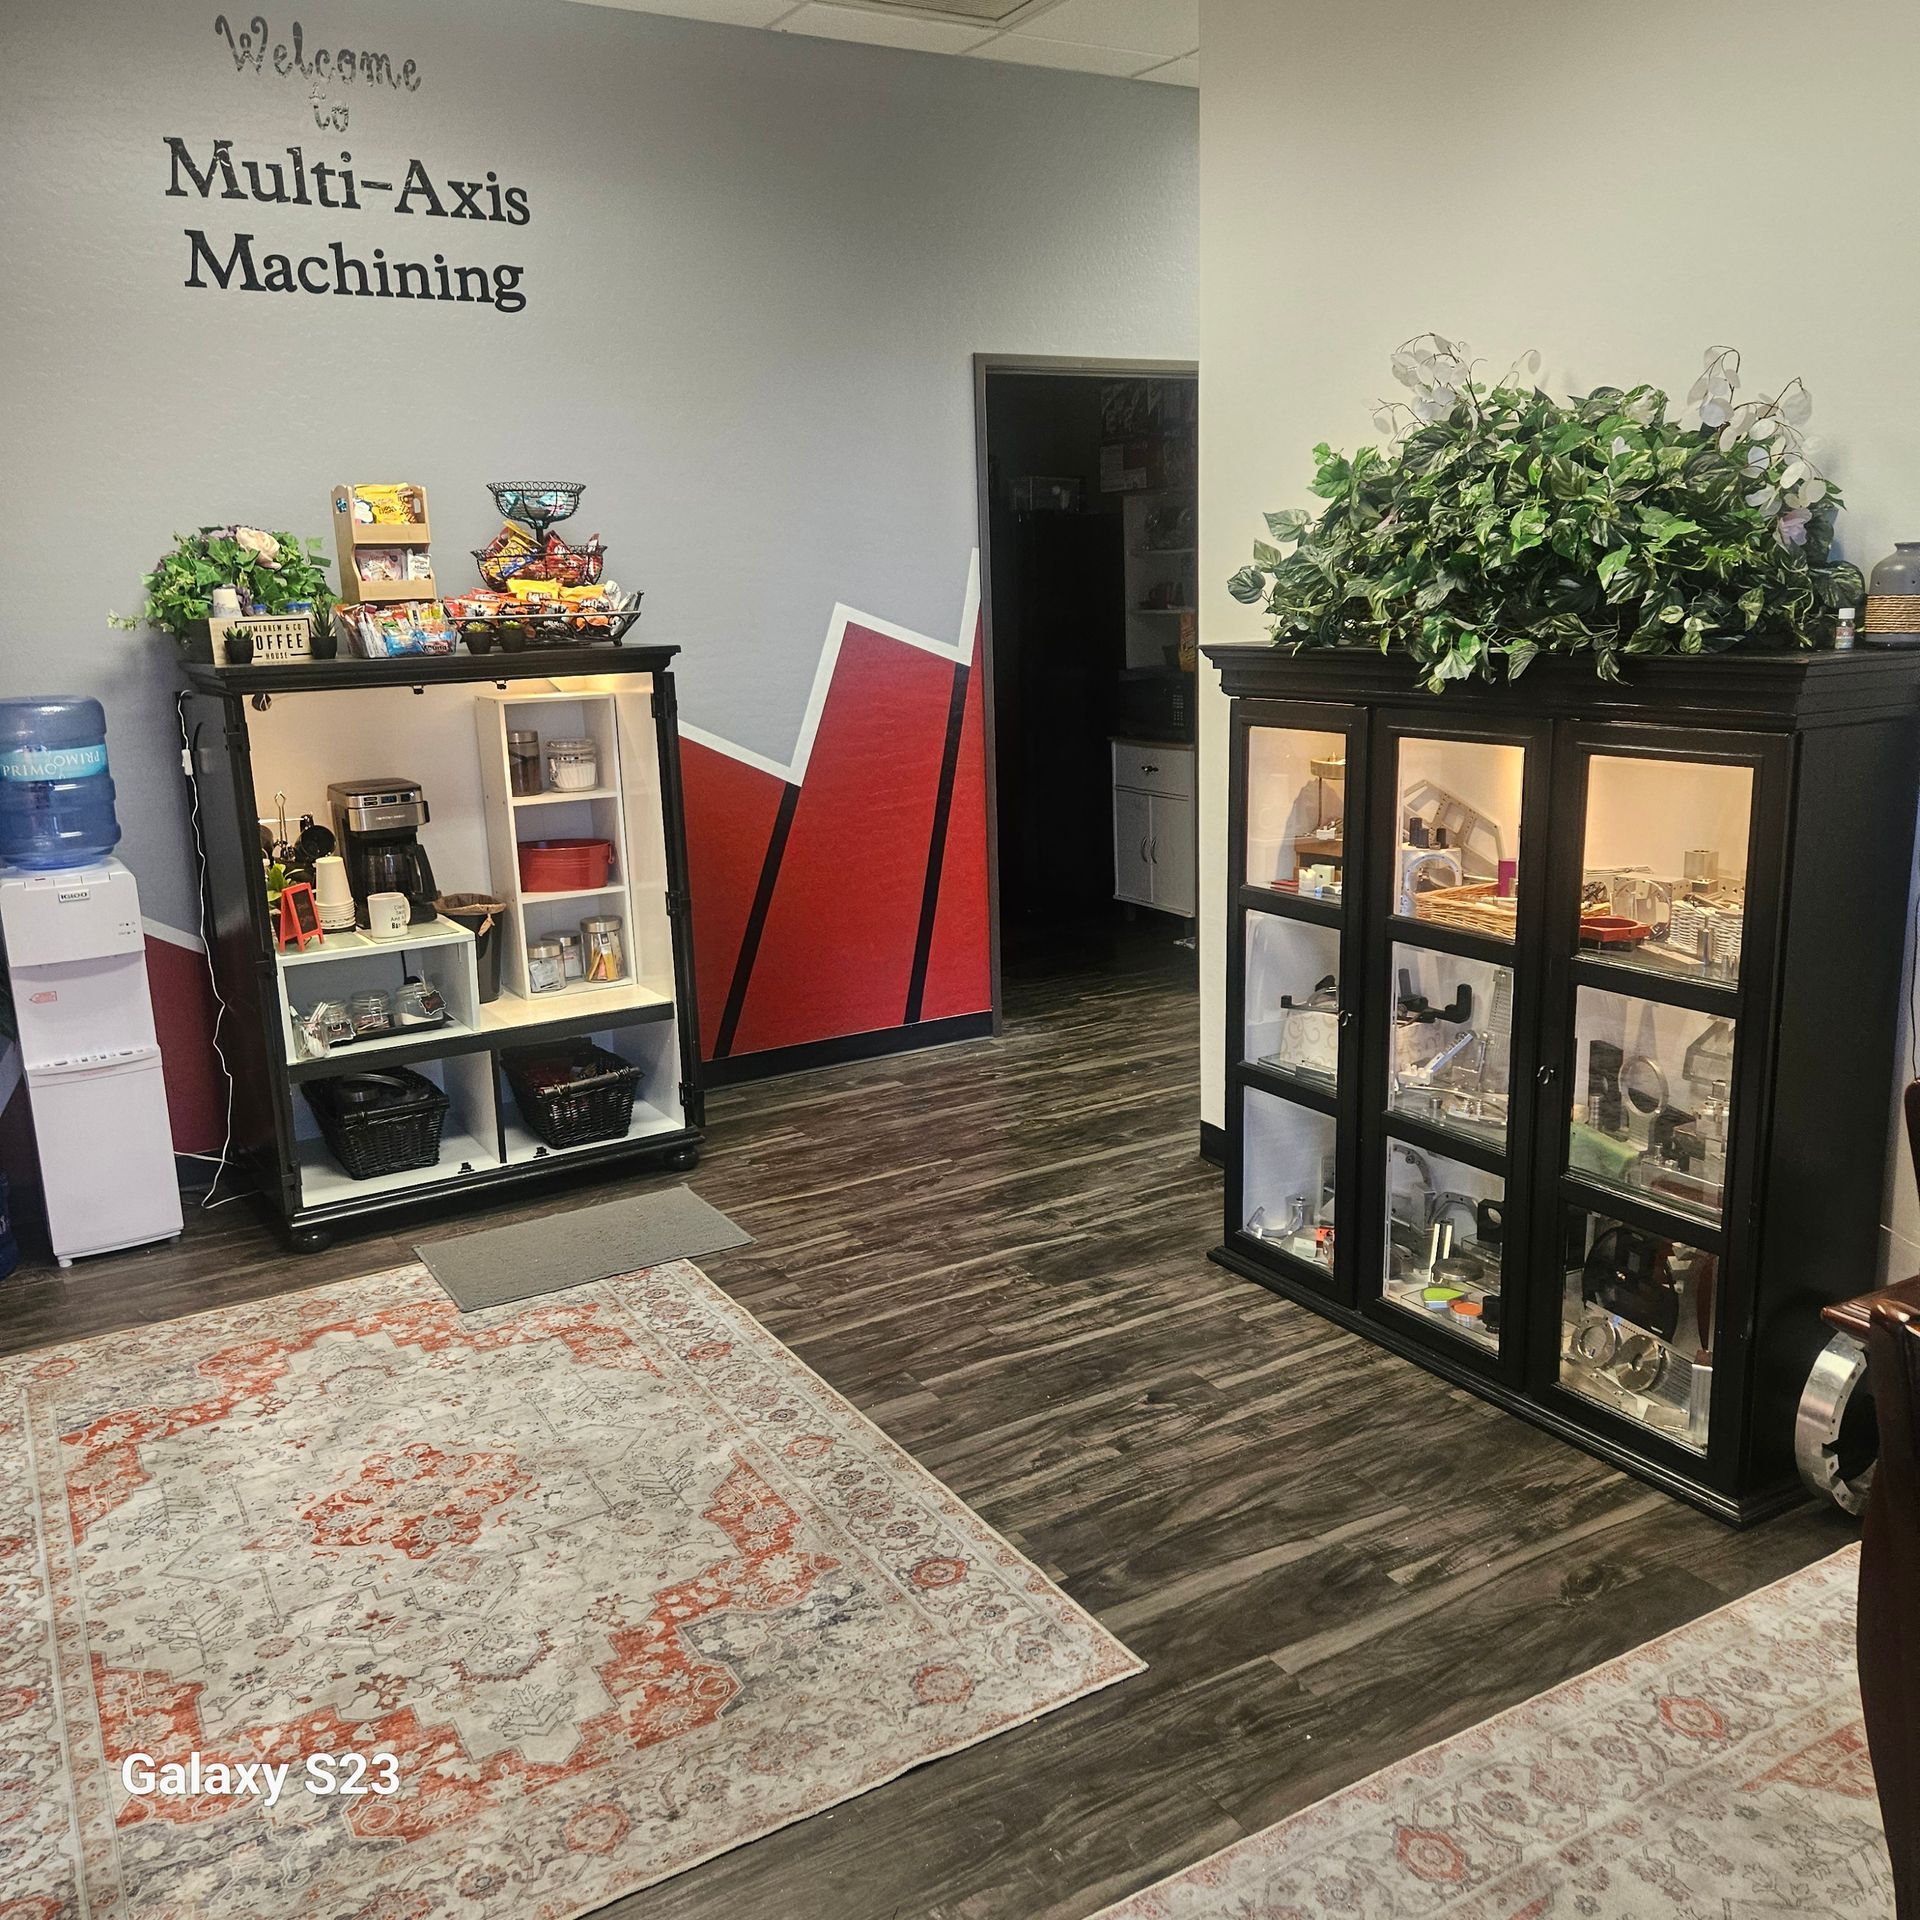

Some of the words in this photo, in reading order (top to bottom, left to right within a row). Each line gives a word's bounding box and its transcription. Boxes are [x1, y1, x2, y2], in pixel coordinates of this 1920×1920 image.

[215, 14, 421, 92] Welcome
[309, 81, 350, 132] to
[163, 136, 531, 226] Multi-Axis
[184, 229, 527, 313] Machining
[255, 633, 304, 651] OFFEE
[265, 652, 289, 660] HOUSE
[2, 763, 57, 777] PRIMO
